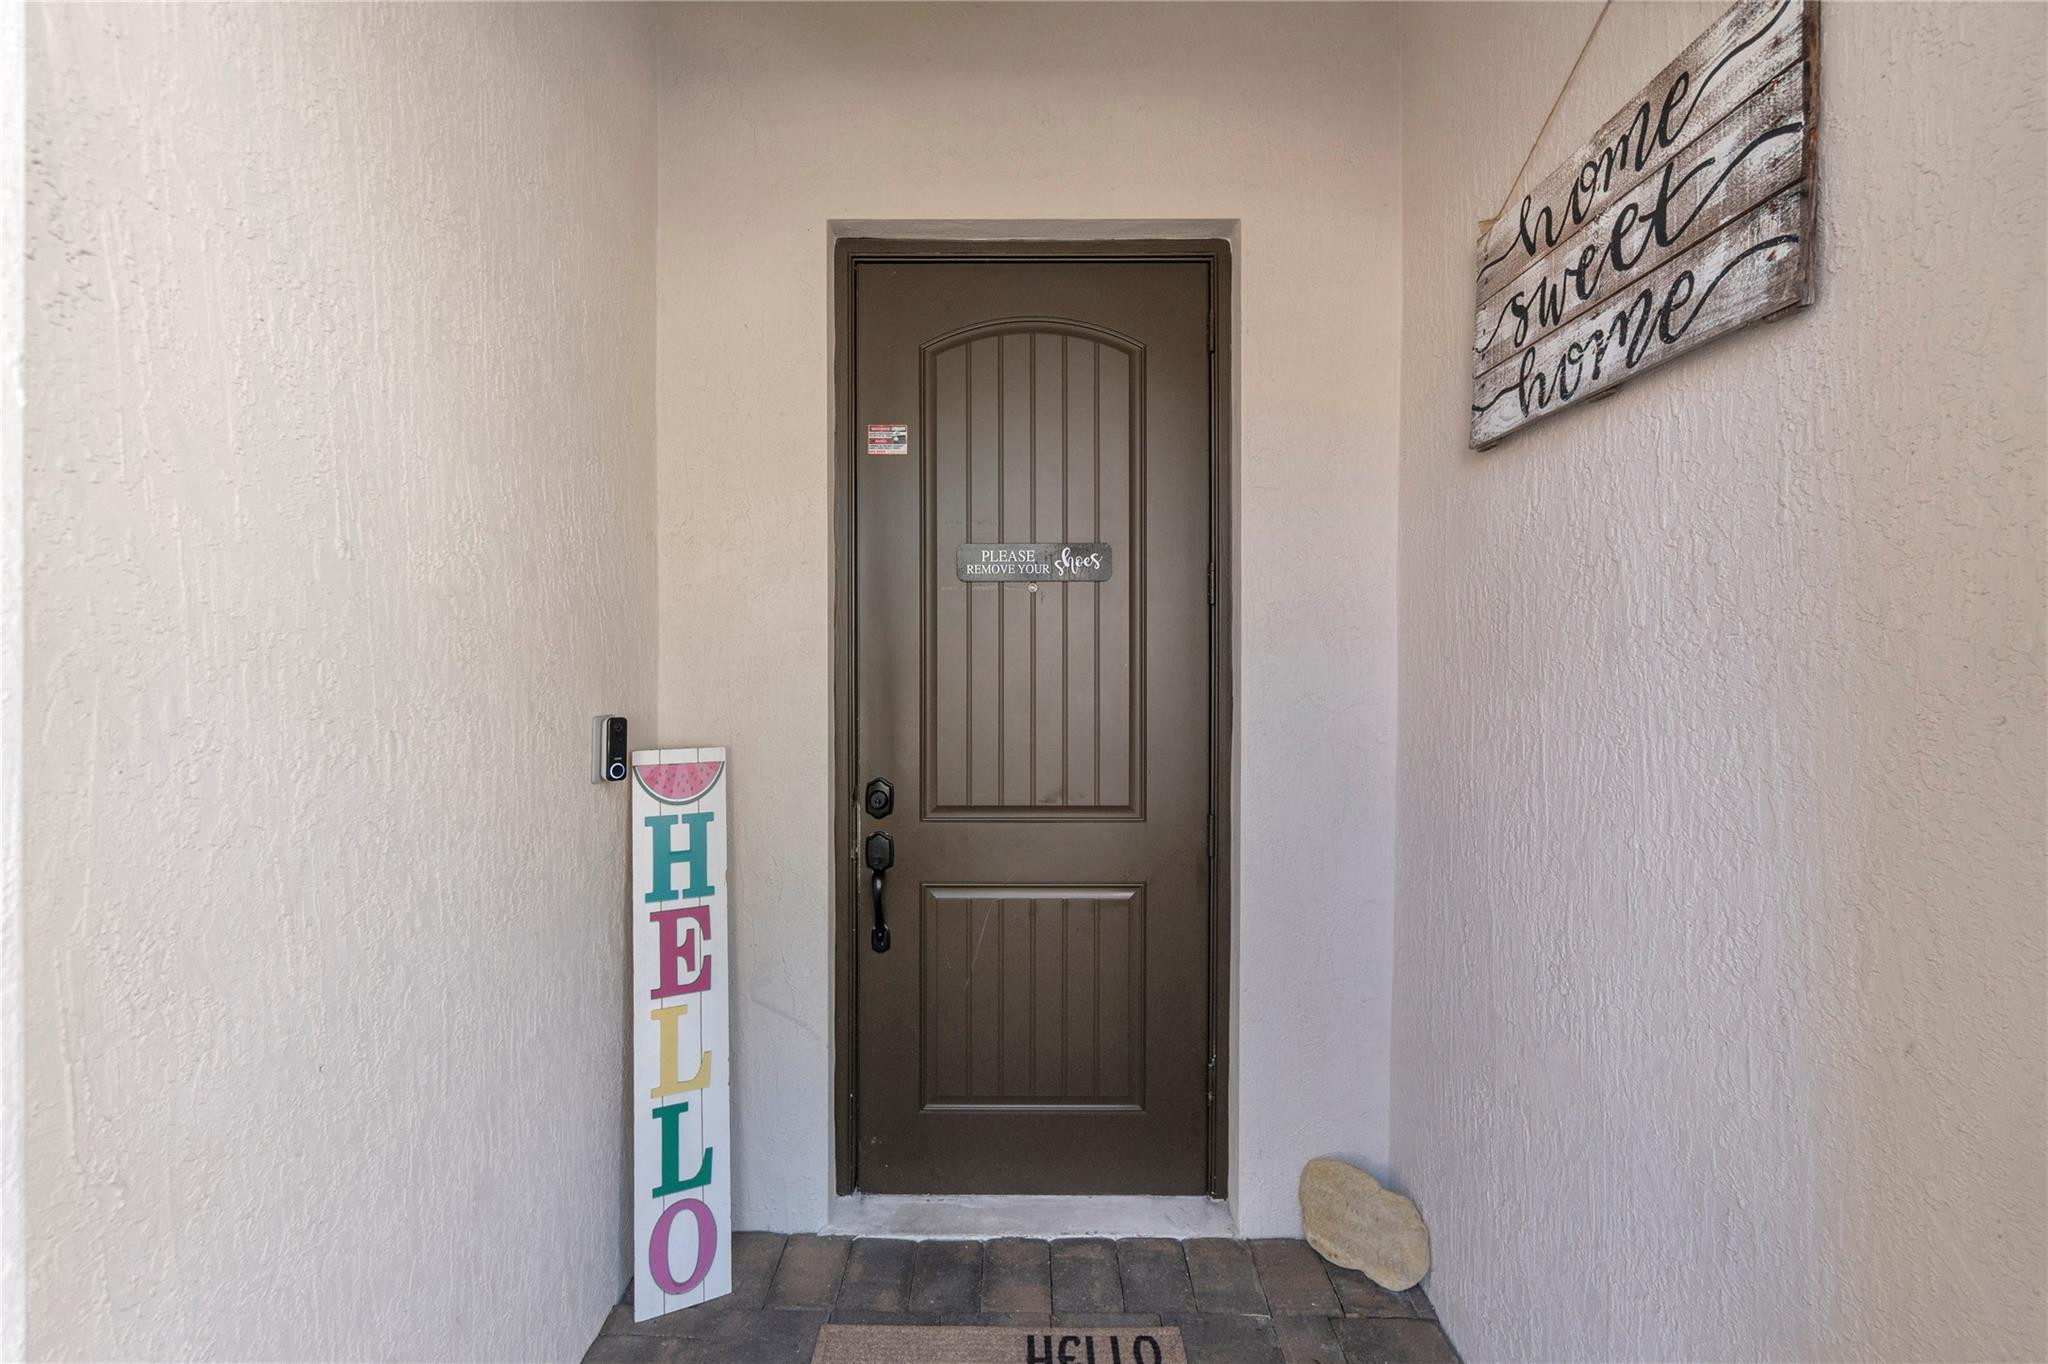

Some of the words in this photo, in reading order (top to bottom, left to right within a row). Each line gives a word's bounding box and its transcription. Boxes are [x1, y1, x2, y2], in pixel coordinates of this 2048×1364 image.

[1472, 234, 1799, 418] home
[1473, 122, 1803, 354] sweet
[966, 564, 1016, 574] REMOVE
[1018, 564, 1050, 574] YOUR
[1054, 547, 1103, 576] shoes
[981, 550, 1035, 562] PLEASE
[644, 813, 717, 1295] HELLO
